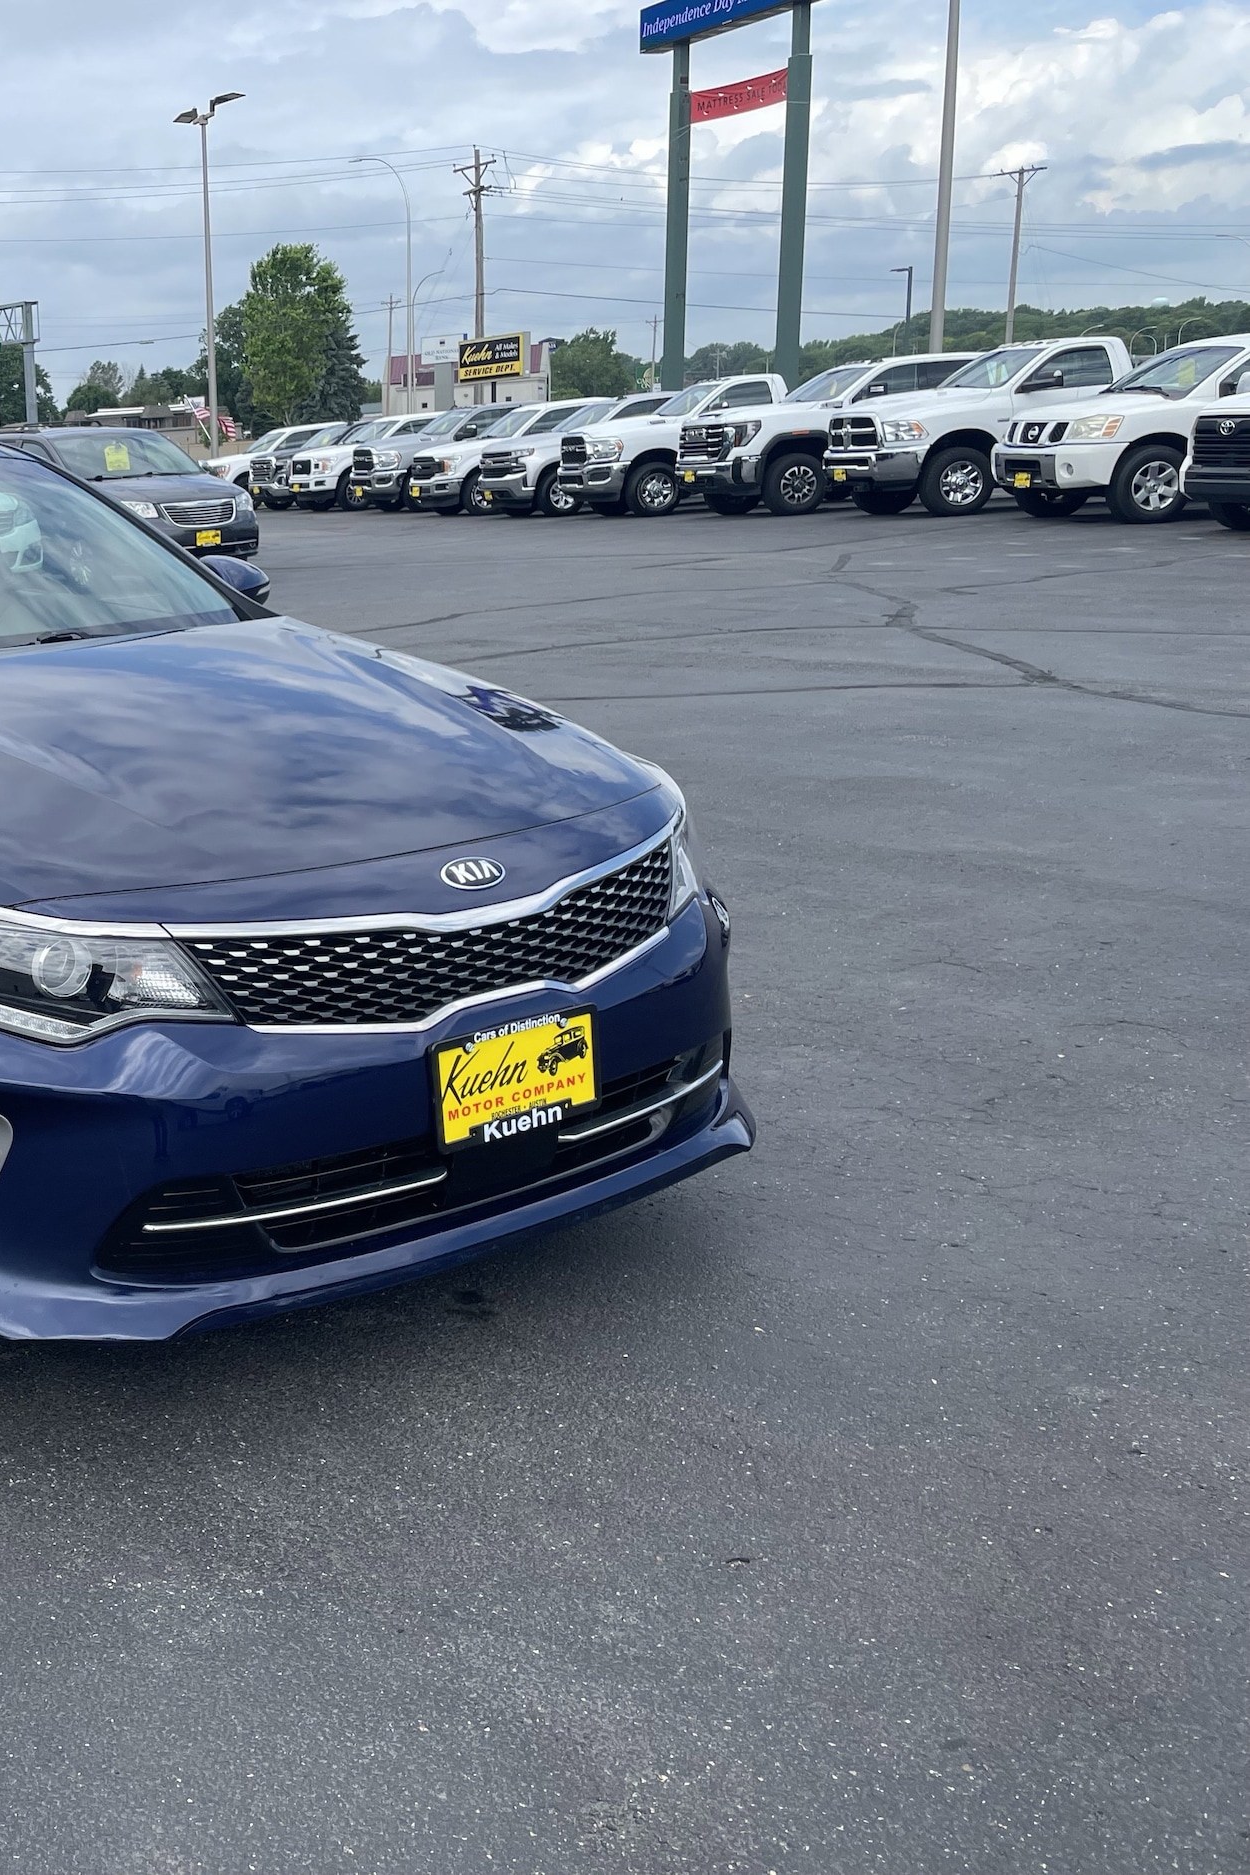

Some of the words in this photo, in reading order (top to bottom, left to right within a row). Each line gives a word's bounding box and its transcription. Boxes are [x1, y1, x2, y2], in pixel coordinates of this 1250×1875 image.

[642, 2, 711, 37] Independence
[713, 0, 735, 13] Day
[697, 92, 743, 111] MATTRESS
[746, 86, 765, 101] SALE
[768, 81, 787, 94] TODA
[461, 343, 493, 365] Kuehn
[464, 366, 493, 377] SERVICE
[495, 363, 516, 373] DEPT.
[449, 860, 501, 884] KIA
[473, 1031, 497, 1044] Cars
[498, 1026, 509, 1037] of
[510, 1013, 561, 1034] Distinction
[442, 1041, 528, 1106] Kuehn
[448, 1096, 504, 1122] MOTOR
[511, 1072, 586, 1102] COMPANY
[483, 1104, 563, 1143] Kuehn
[491, 1104, 522, 1121] ROCHESTER
